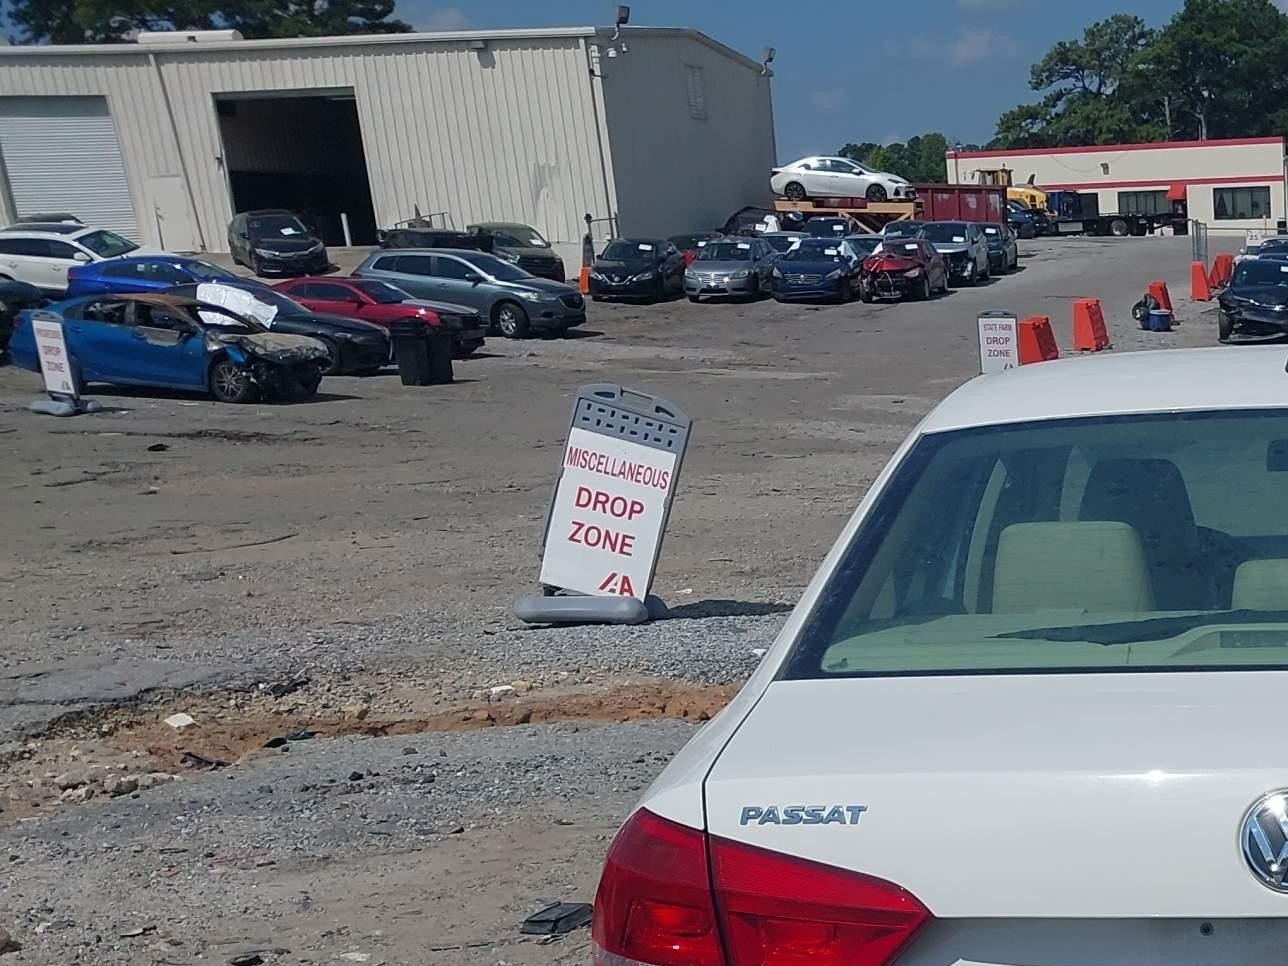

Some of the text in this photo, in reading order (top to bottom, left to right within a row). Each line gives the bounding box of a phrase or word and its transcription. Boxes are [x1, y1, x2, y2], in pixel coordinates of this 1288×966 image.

[983, 323, 998, 332] STATE
[986, 336, 1011, 345] DROP
[987, 349, 1012, 358] ZONE
[566, 446, 670, 490] MISCELLANEOUS
[574, 486, 645, 521] DROP
[567, 521, 636, 557] ZONE
[739, 804, 868, 826] PASSAT
